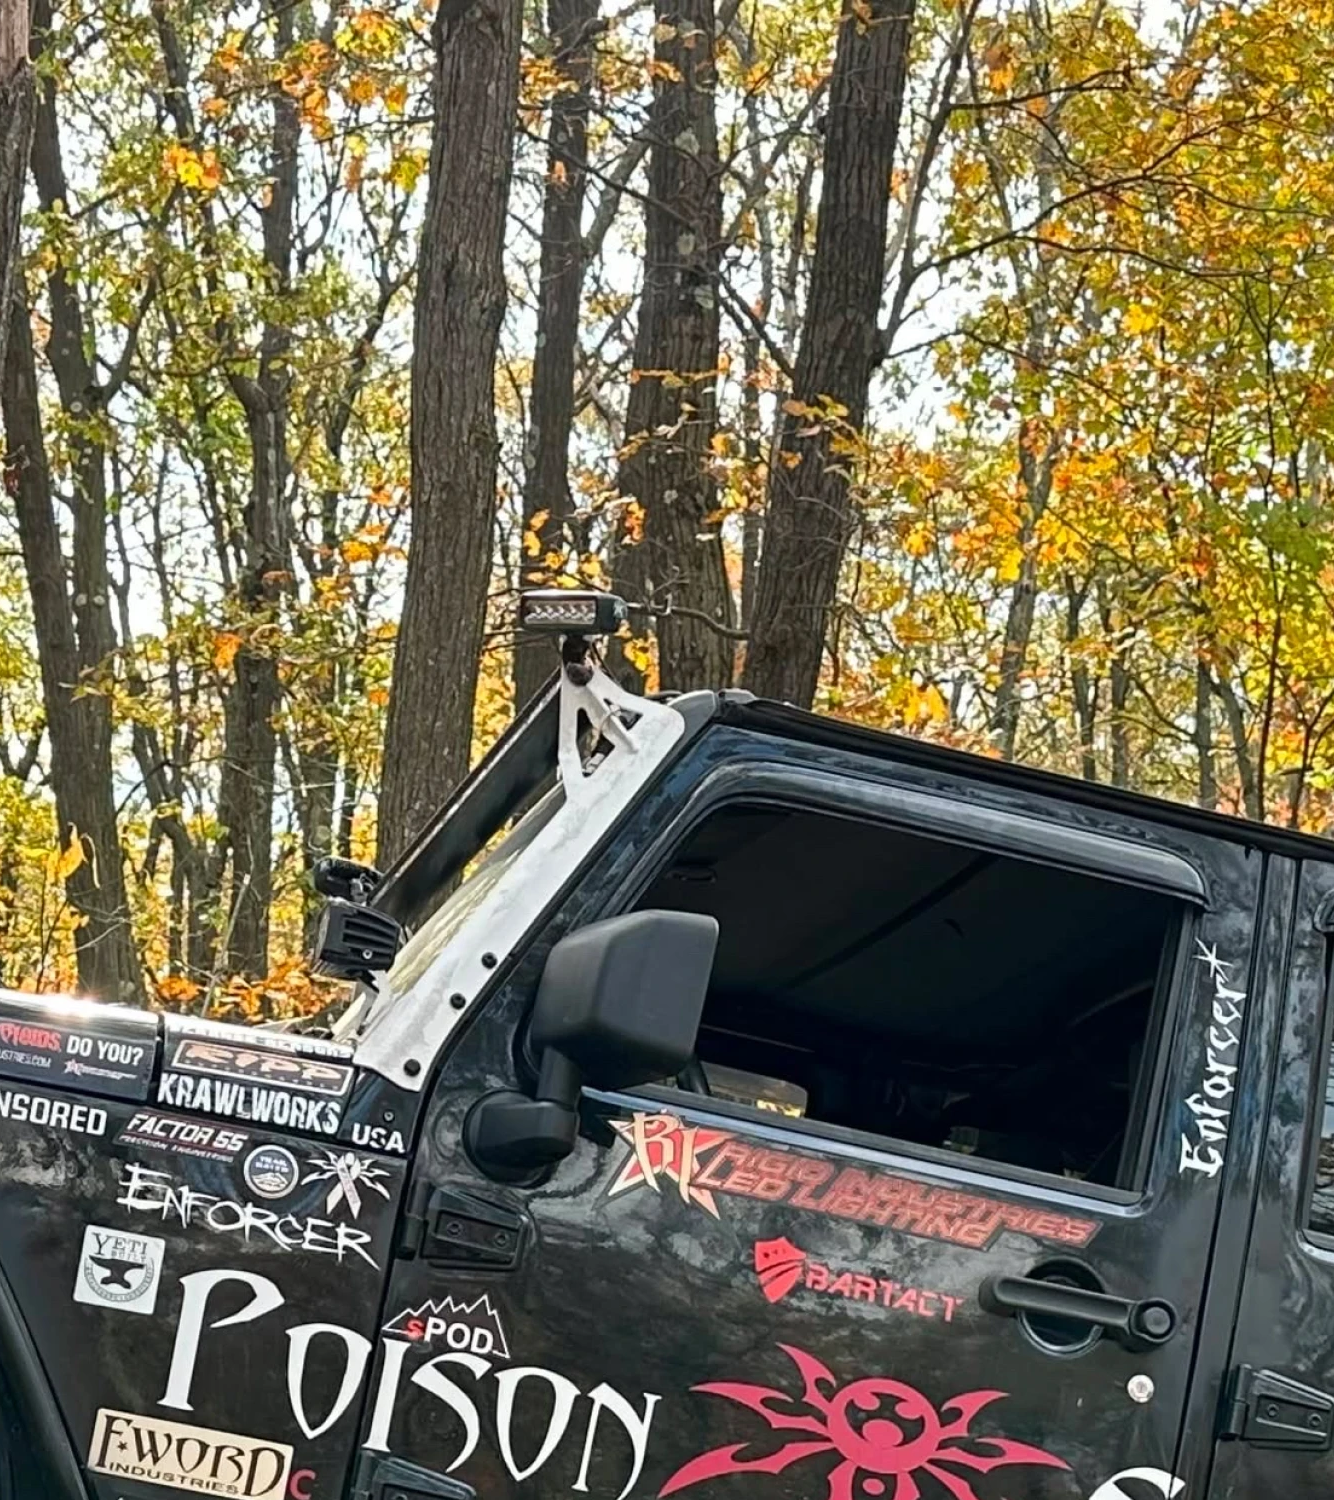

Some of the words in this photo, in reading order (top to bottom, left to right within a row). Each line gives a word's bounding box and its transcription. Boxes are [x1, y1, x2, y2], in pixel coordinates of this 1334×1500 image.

[67, 1035, 91, 1057] DO
[97, 1040, 144, 1066] YOU?
[126, 1113, 211, 1146] FACTOR
[213, 1131, 249, 1152] 55
[157, 1073, 342, 1134] KRAWLWORKS
[352, 1122, 405, 1153] USA
[117, 1162, 381, 1272] ENFORCER
[92, 1232, 148, 1255] YETI
[805, 1263, 965, 1322] BARTACT
[109, 1462, 239, 1495] INDUSTRIES
